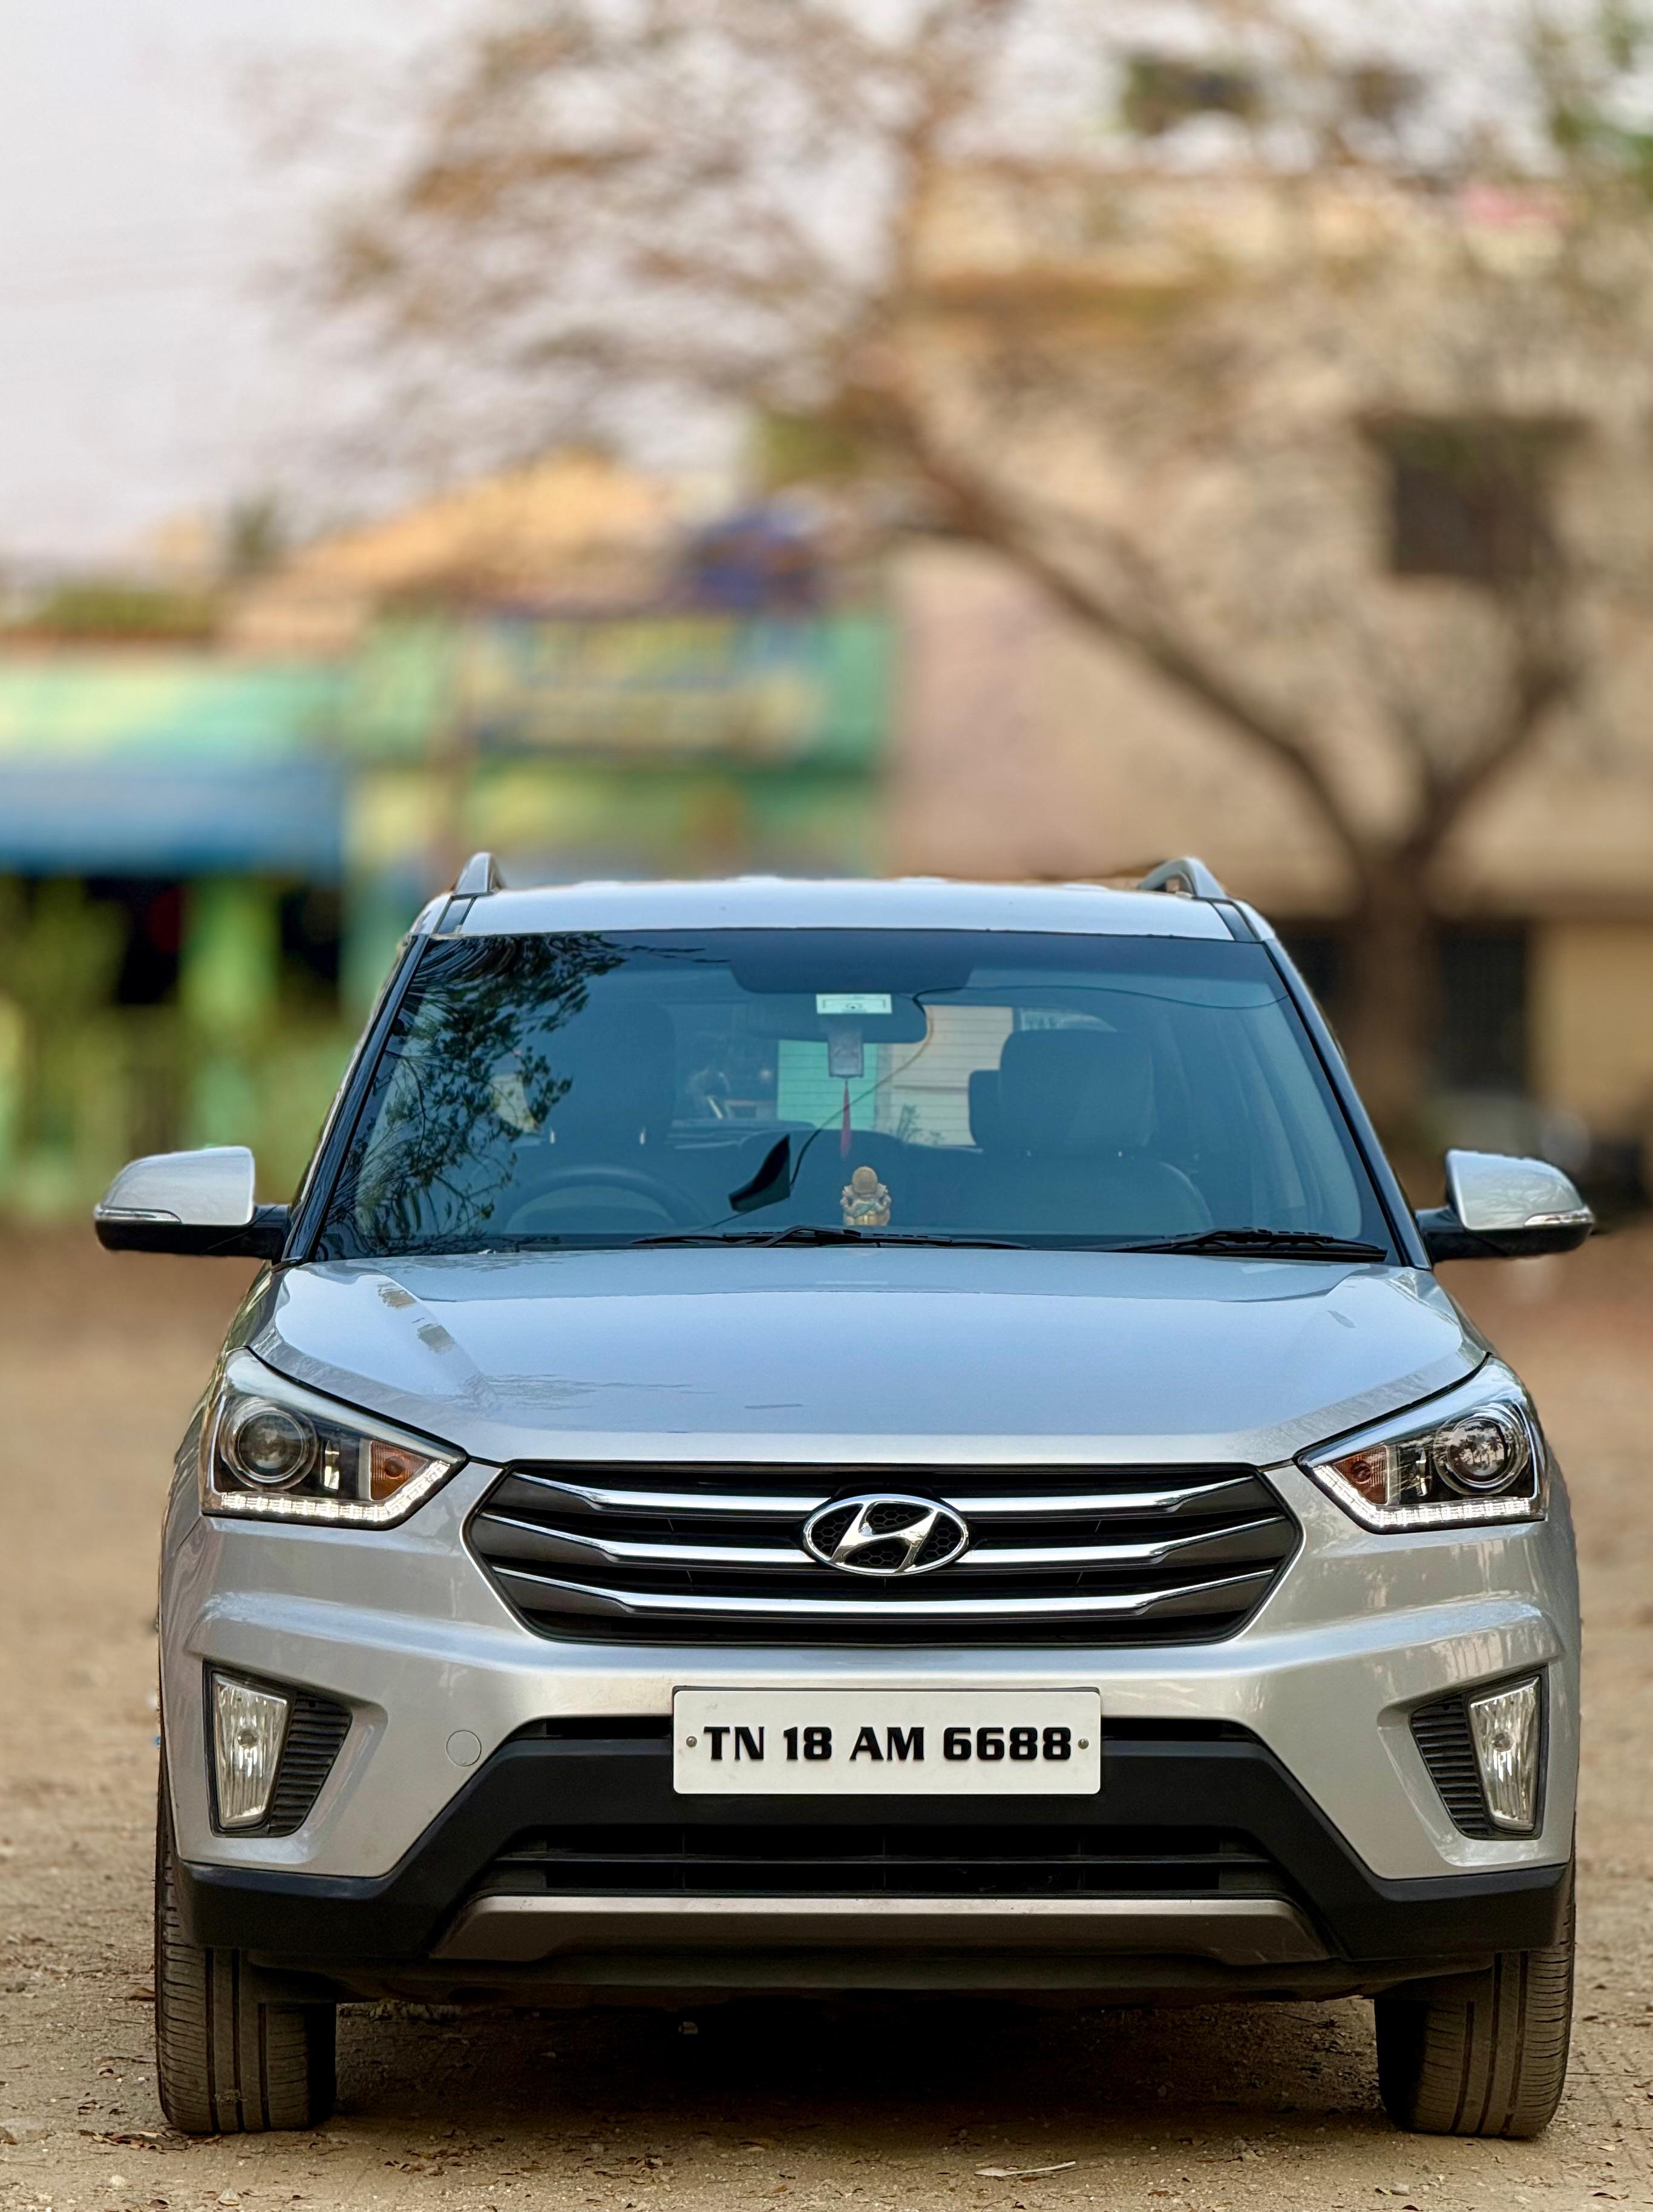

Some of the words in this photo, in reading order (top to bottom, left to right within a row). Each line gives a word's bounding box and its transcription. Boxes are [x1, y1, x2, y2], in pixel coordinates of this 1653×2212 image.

[703, 1726, 765, 1761] TN
[783, 1727, 832, 1761] 18
[849, 1727, 925, 1761] AM
[943, 1727, 1071, 1761] 6688
